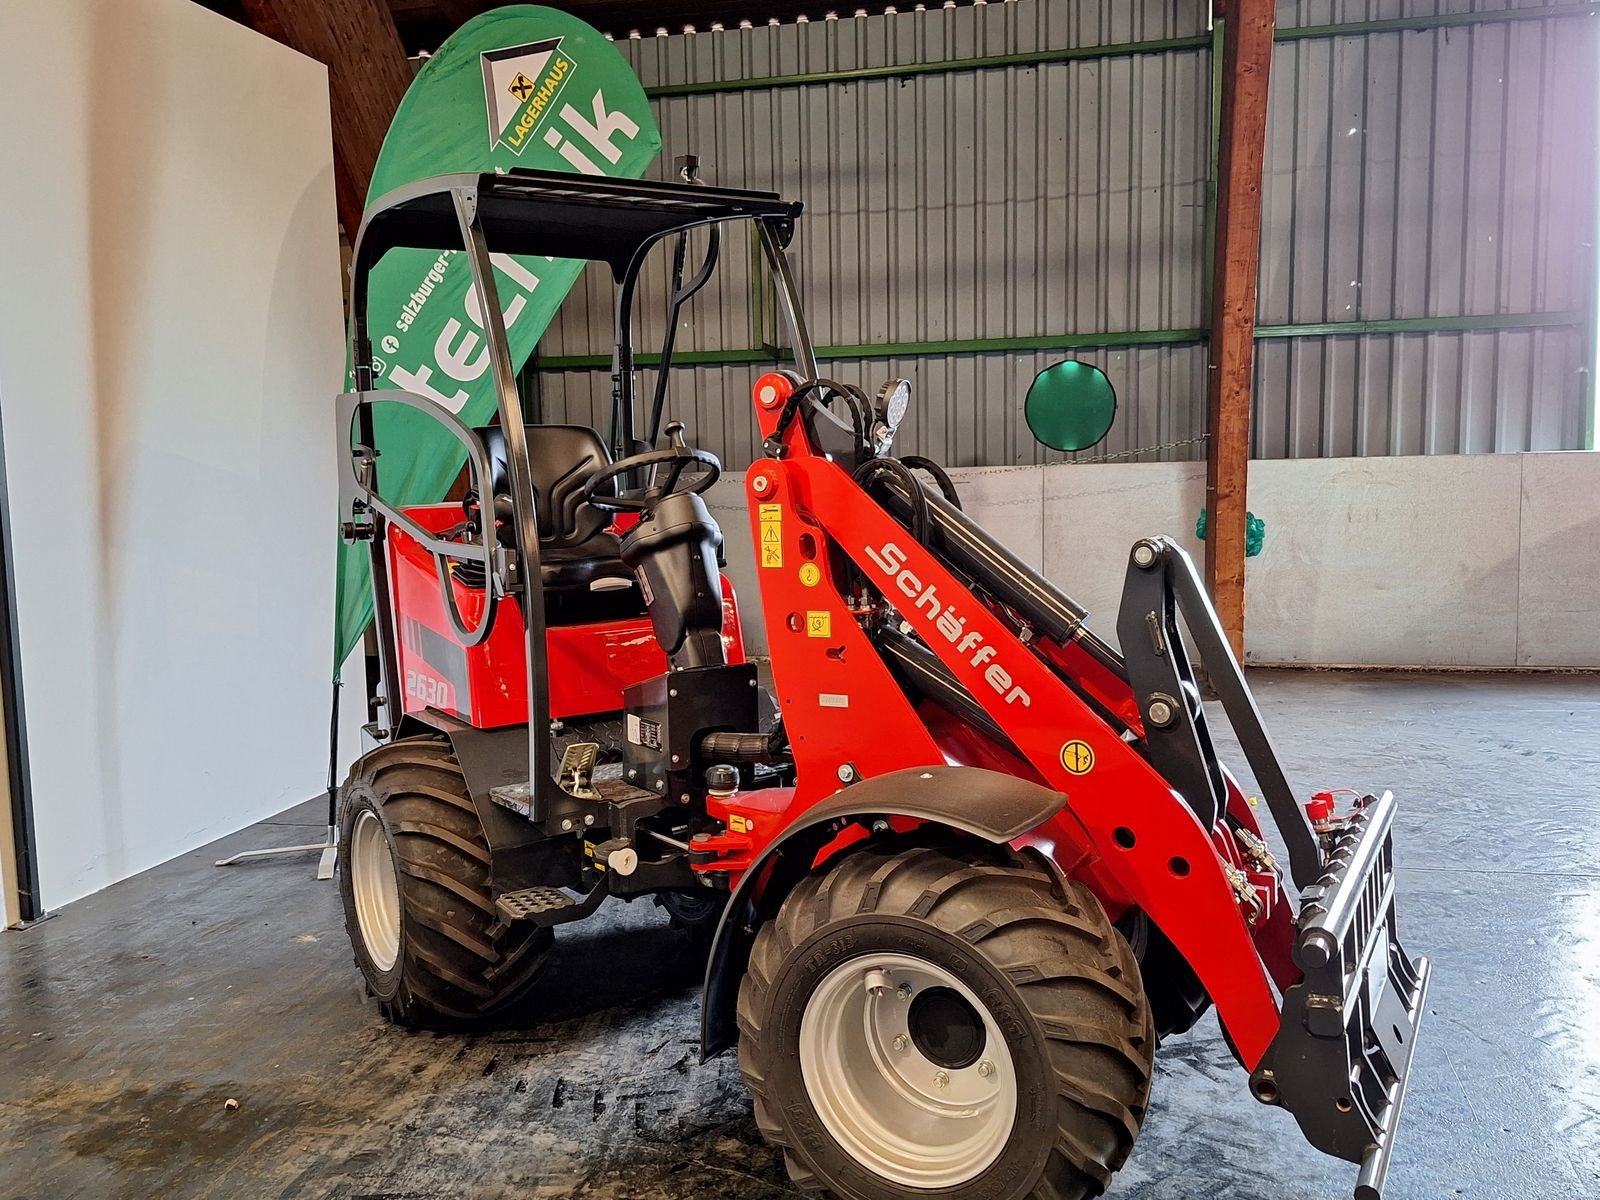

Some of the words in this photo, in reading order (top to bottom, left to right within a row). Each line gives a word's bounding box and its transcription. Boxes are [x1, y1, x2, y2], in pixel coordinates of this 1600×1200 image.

[508, 57, 570, 148] LAGERHAUS
[864, 542, 1031, 708] Schäffer
[407, 669, 448, 708] 2630
